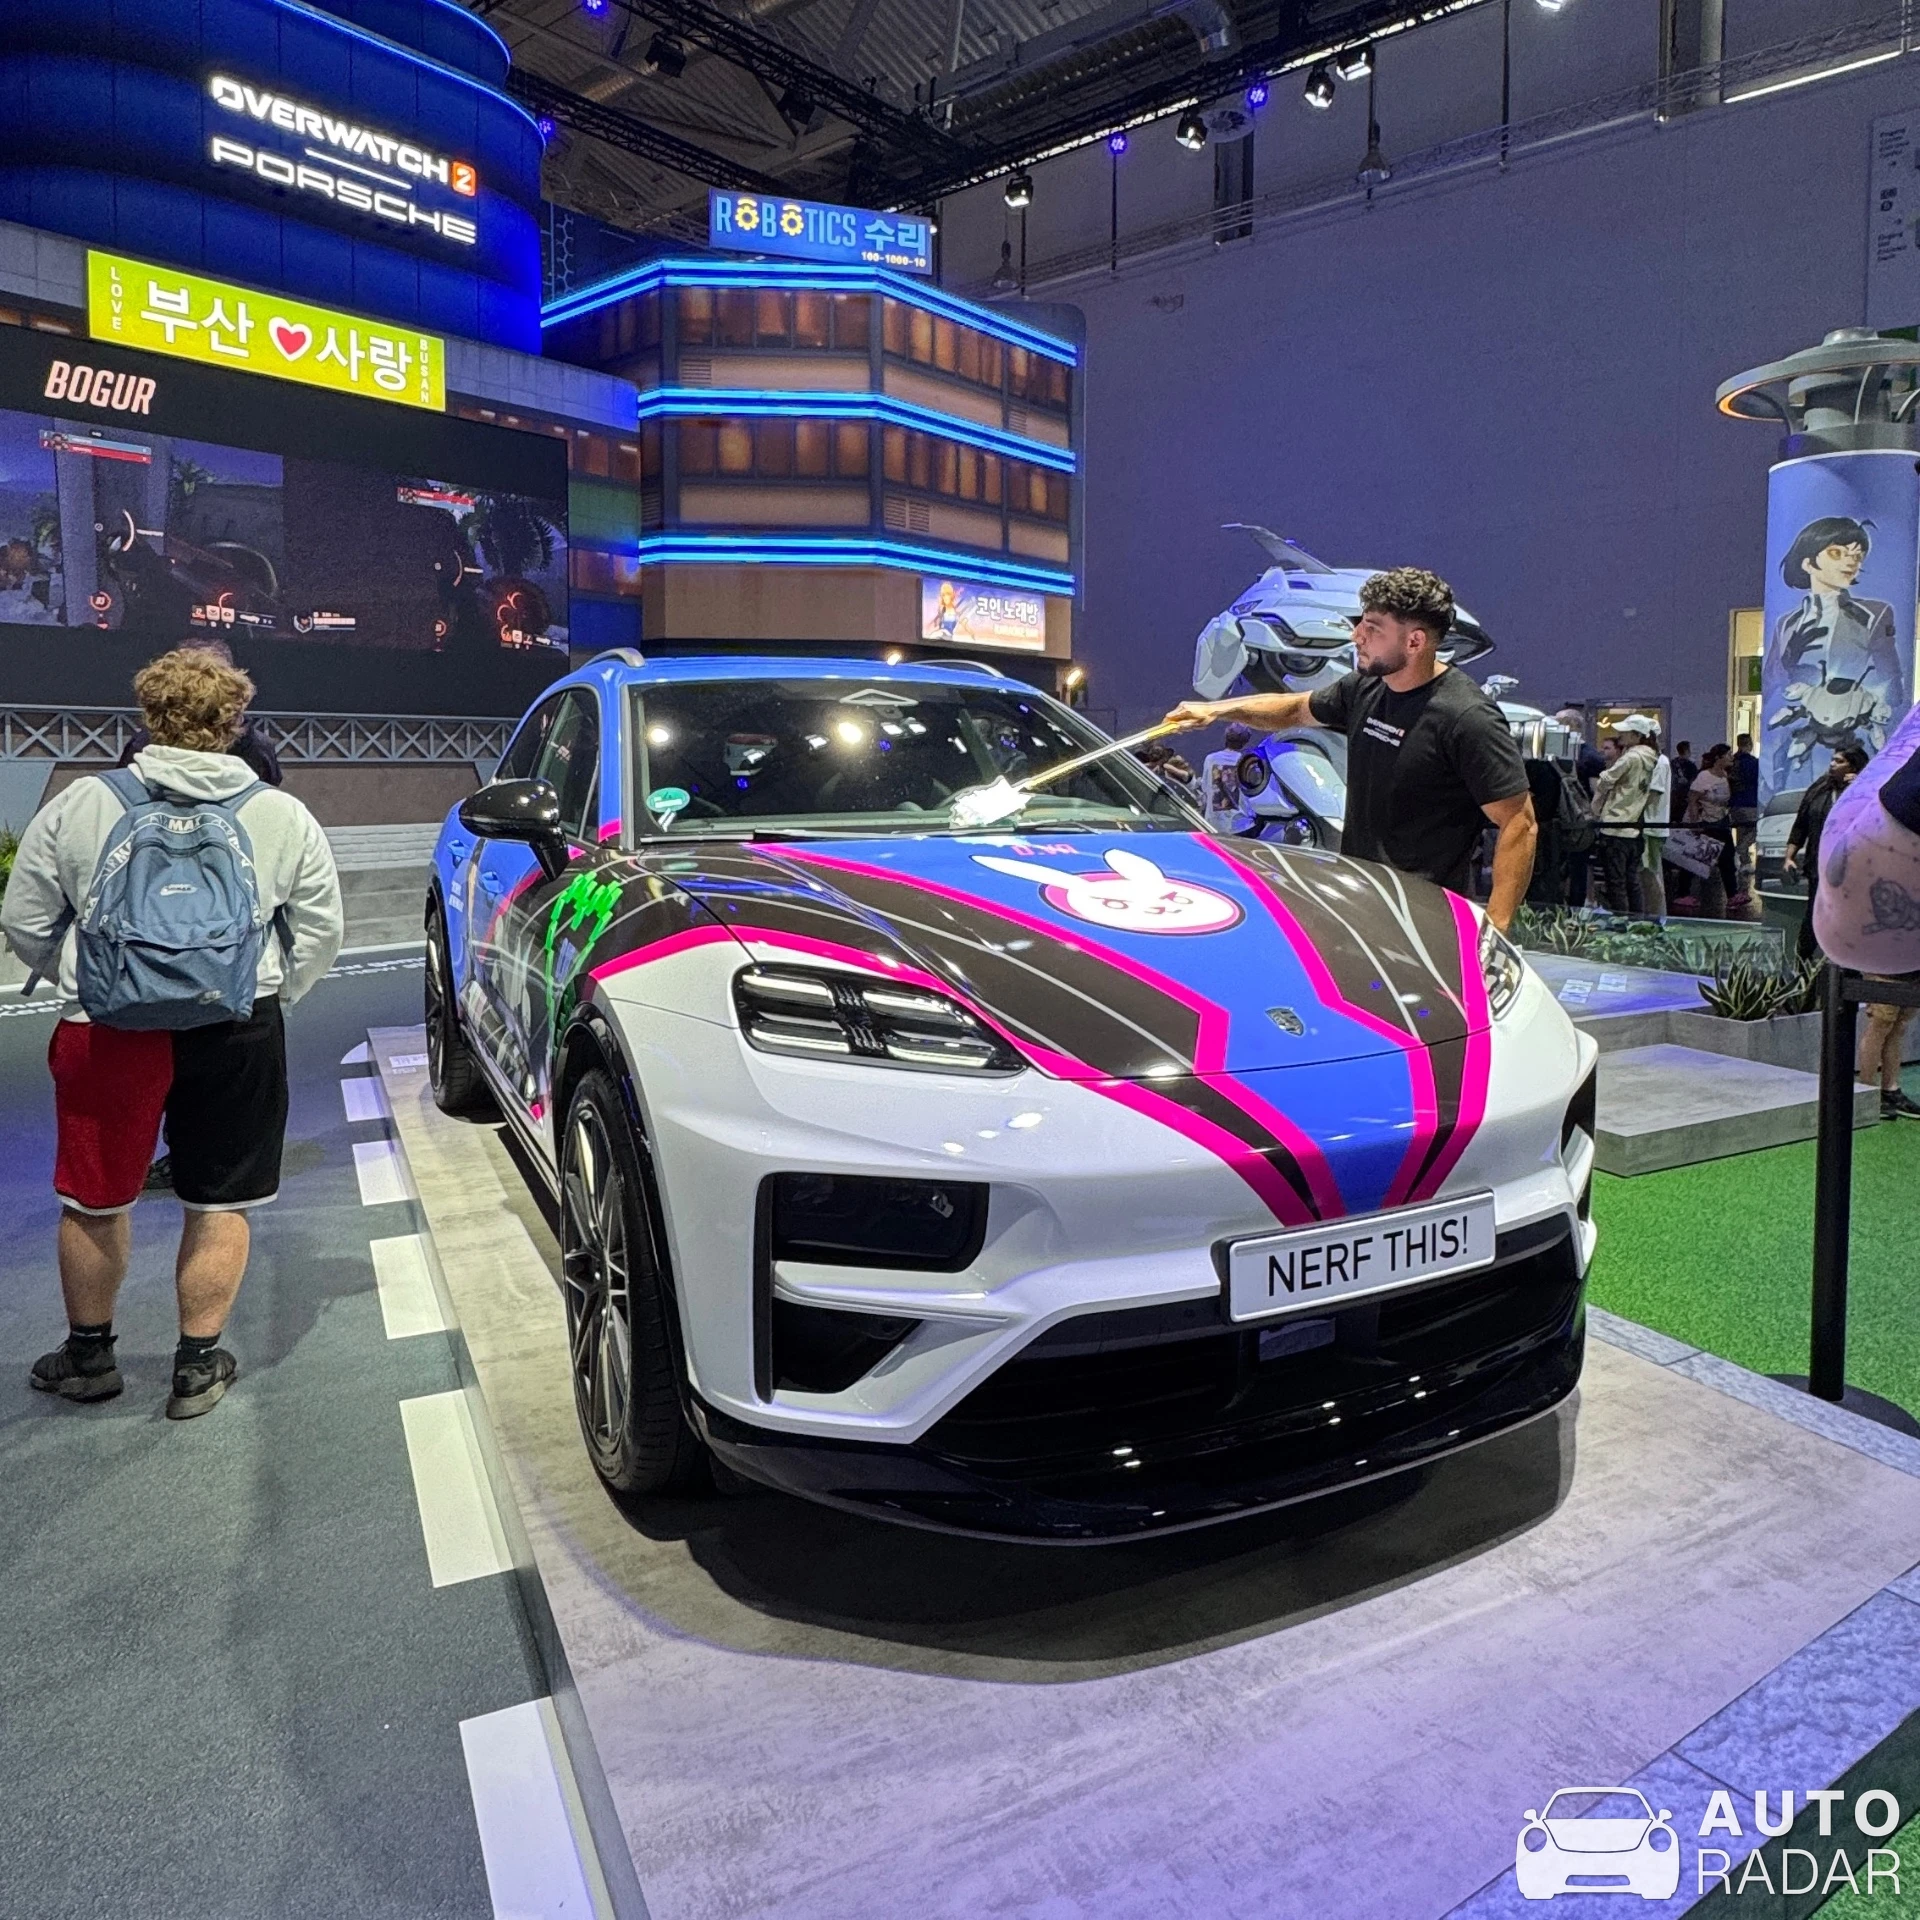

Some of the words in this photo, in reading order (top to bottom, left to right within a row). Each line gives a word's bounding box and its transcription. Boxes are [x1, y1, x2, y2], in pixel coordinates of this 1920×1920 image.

[211, 75, 449, 185] OVERWATCH
[211, 137, 477, 246] PORSCHE
[716, 196, 857, 247] ROBOTICS
[864, 219, 926, 256] 수리
[110, 266, 122, 332] LOVE
[140, 280, 255, 359] 부산
[315, 327, 413, 393] 사랑
[44, 360, 157, 416] BOGUR
[418, 338, 430, 404] BUSAN
[976, 596, 1001, 620] 코인
[1003, 600, 1039, 625] 노래방
[1268, 1236, 1374, 1297] NERF
[1383, 1216, 1468, 1273] THIS!
